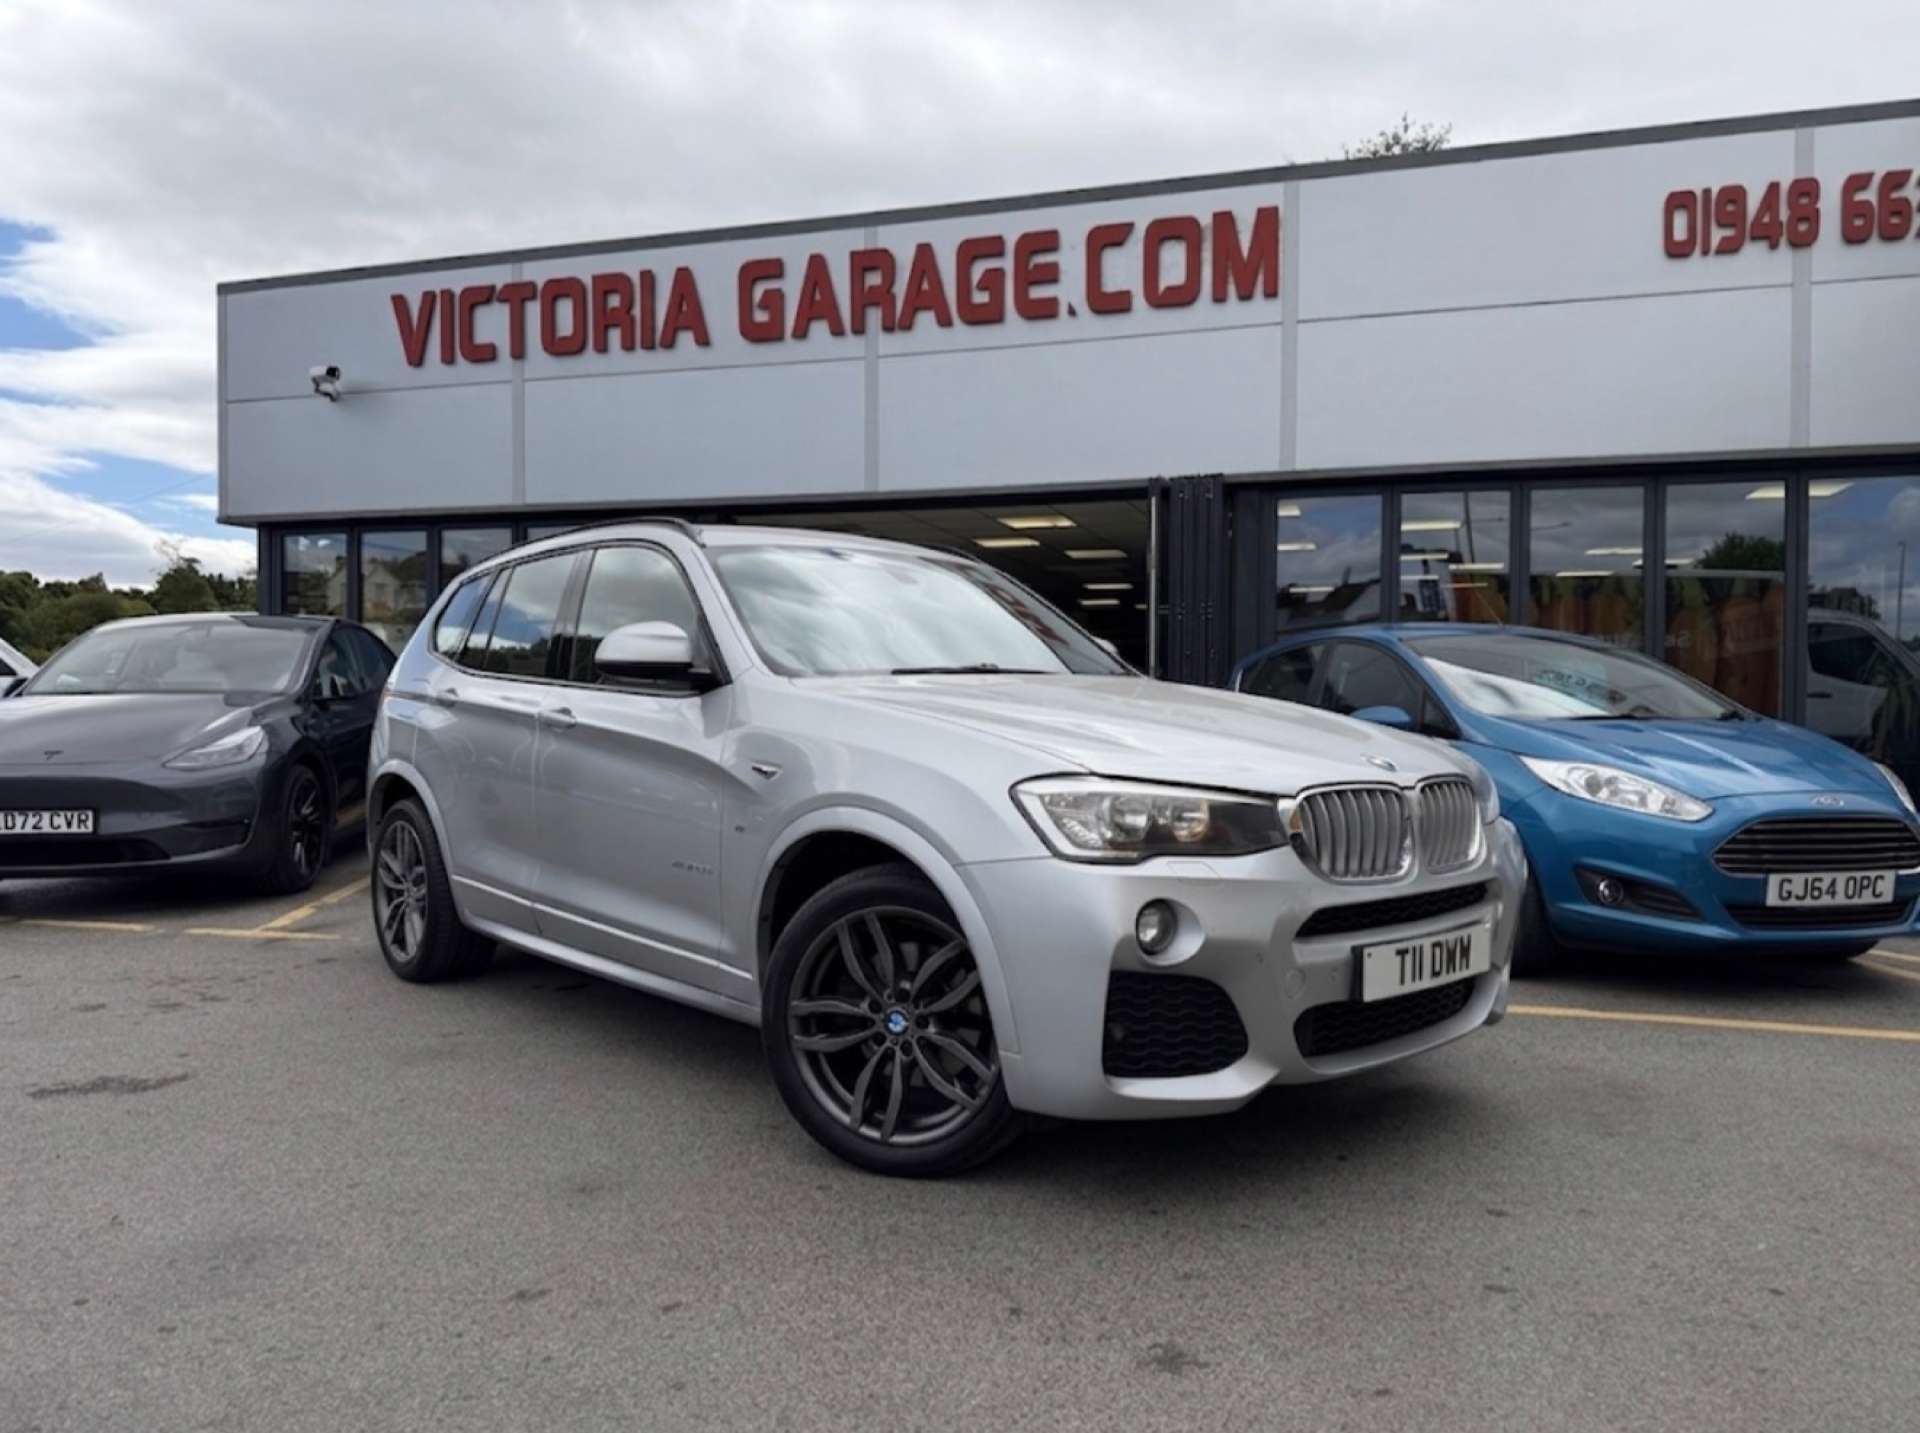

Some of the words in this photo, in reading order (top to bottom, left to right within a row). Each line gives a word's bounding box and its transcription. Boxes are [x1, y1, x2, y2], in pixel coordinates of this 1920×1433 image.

[1663, 177, 1821, 258] 01948
[390, 266, 711, 367] VICTORIA
[738, 206, 1279, 343] GARAGE.COM
[0, 811, 43, 831] D72
[49, 811, 90, 830] CVR
[1778, 877, 1838, 901] GJ64
[1844, 875, 1885, 900] OPC
